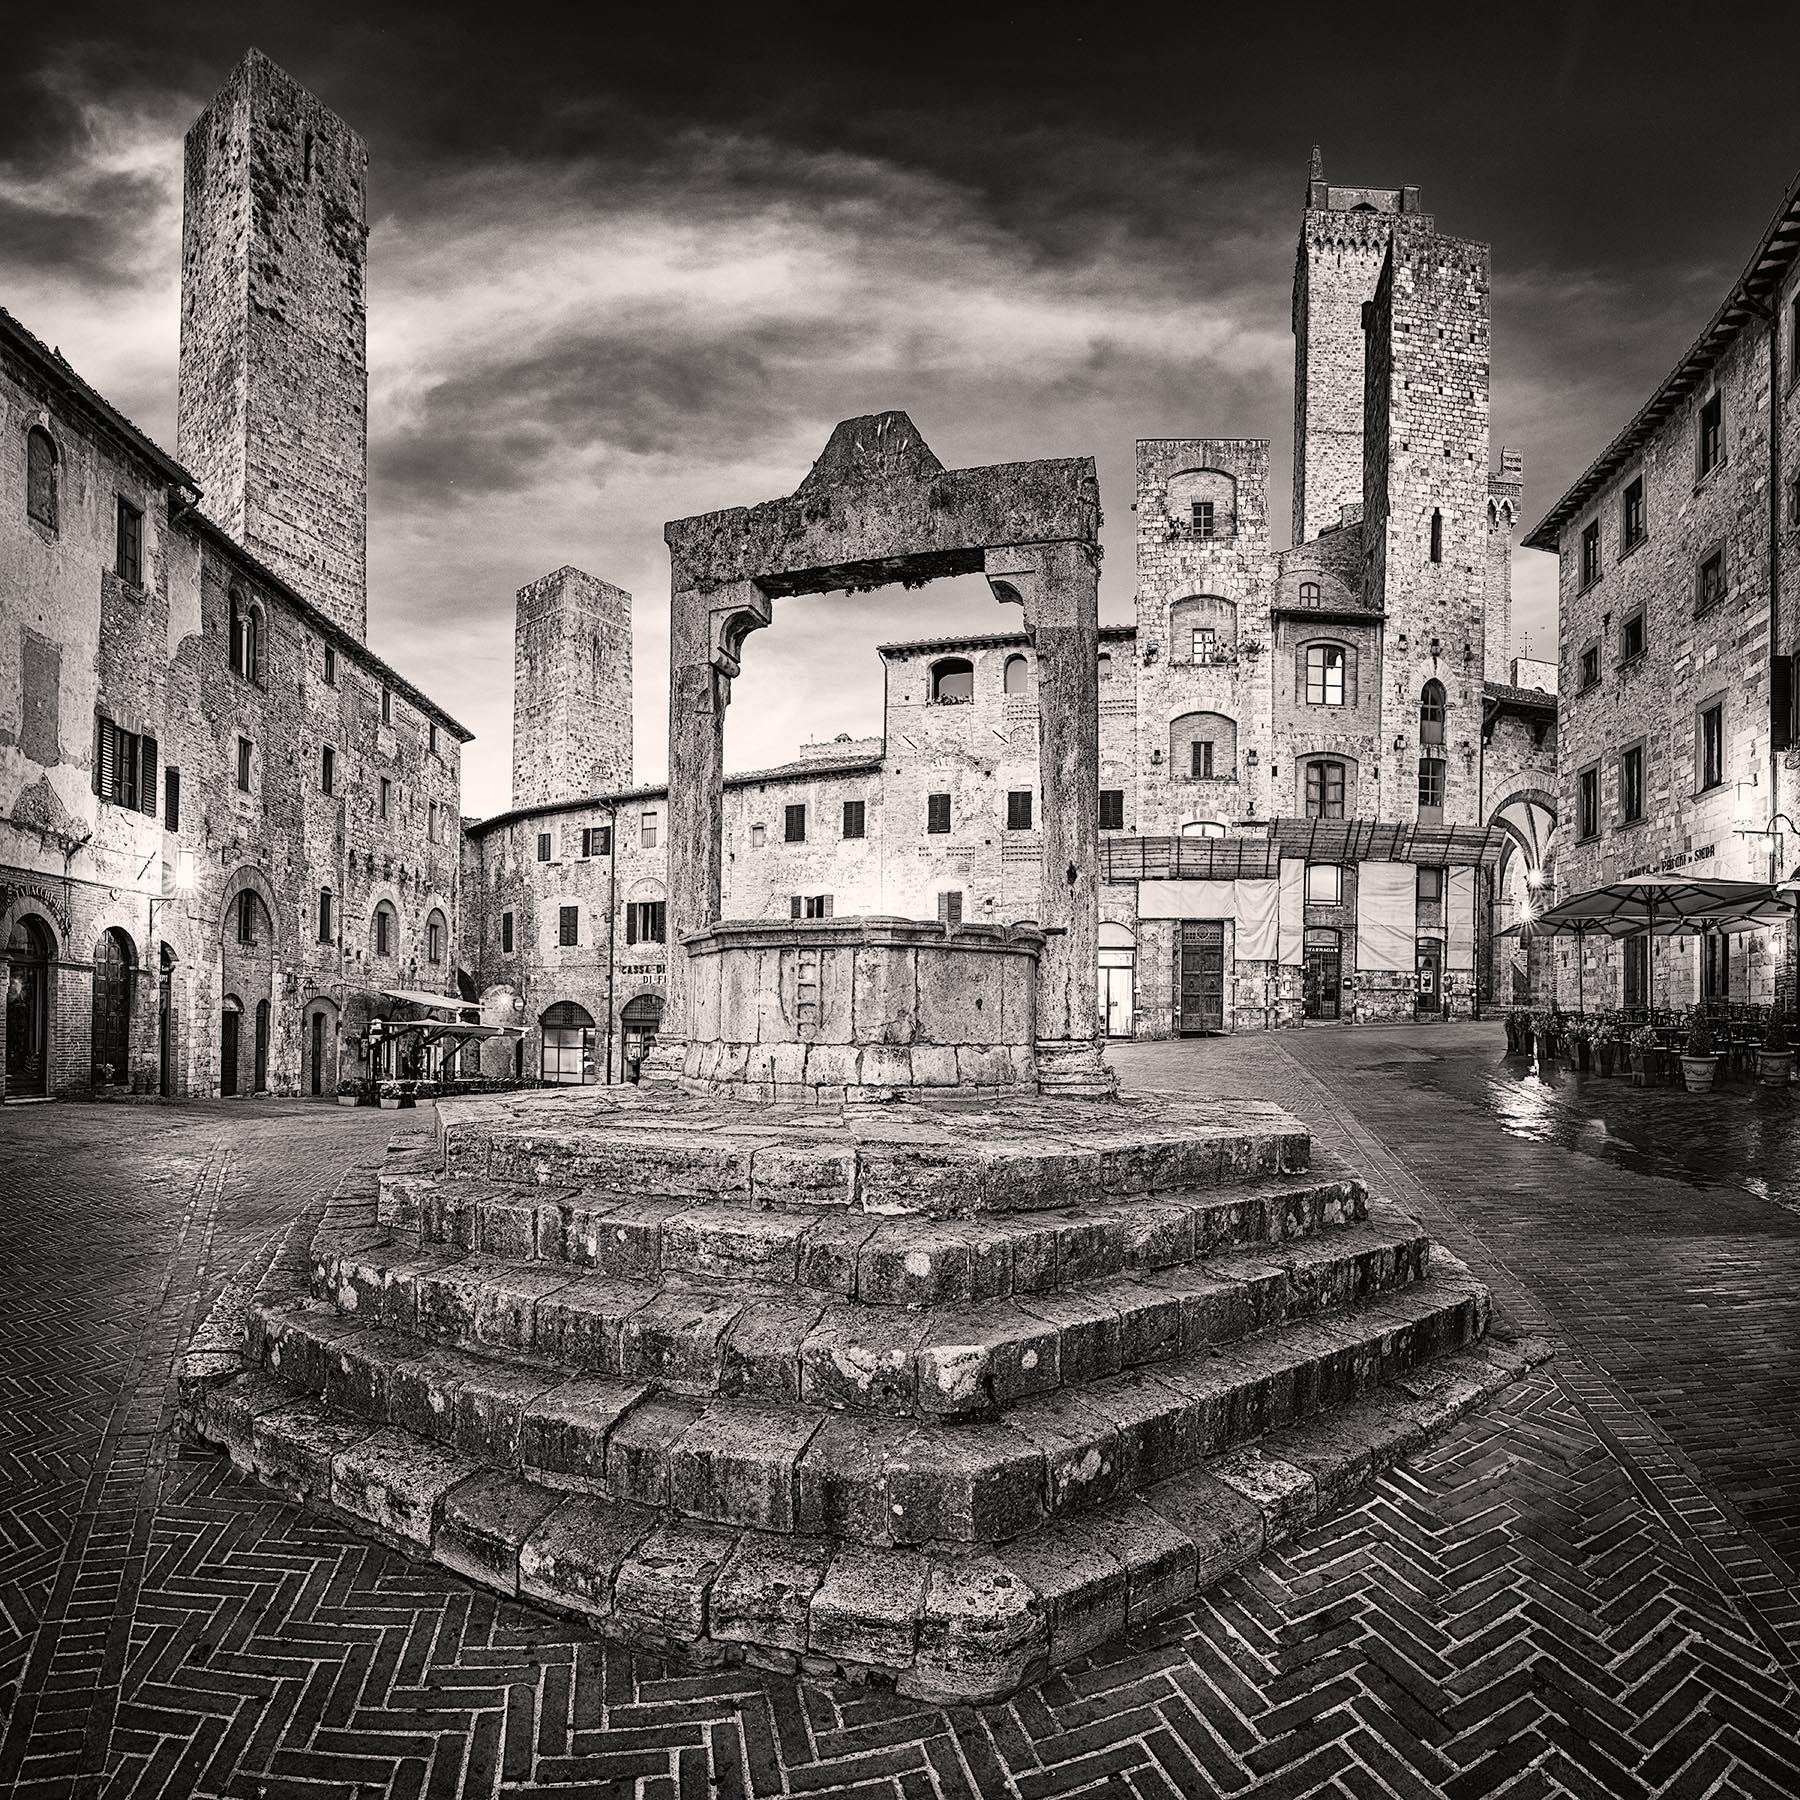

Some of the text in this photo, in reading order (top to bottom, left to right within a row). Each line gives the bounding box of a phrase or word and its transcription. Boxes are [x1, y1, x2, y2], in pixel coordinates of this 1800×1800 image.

[1661, 855, 1687, 872] PASCHI
[1694, 844, 1715, 862] SIENA
[621, 964, 666, 975] CASSA DI
[643, 975, 667, 984] DI FI
